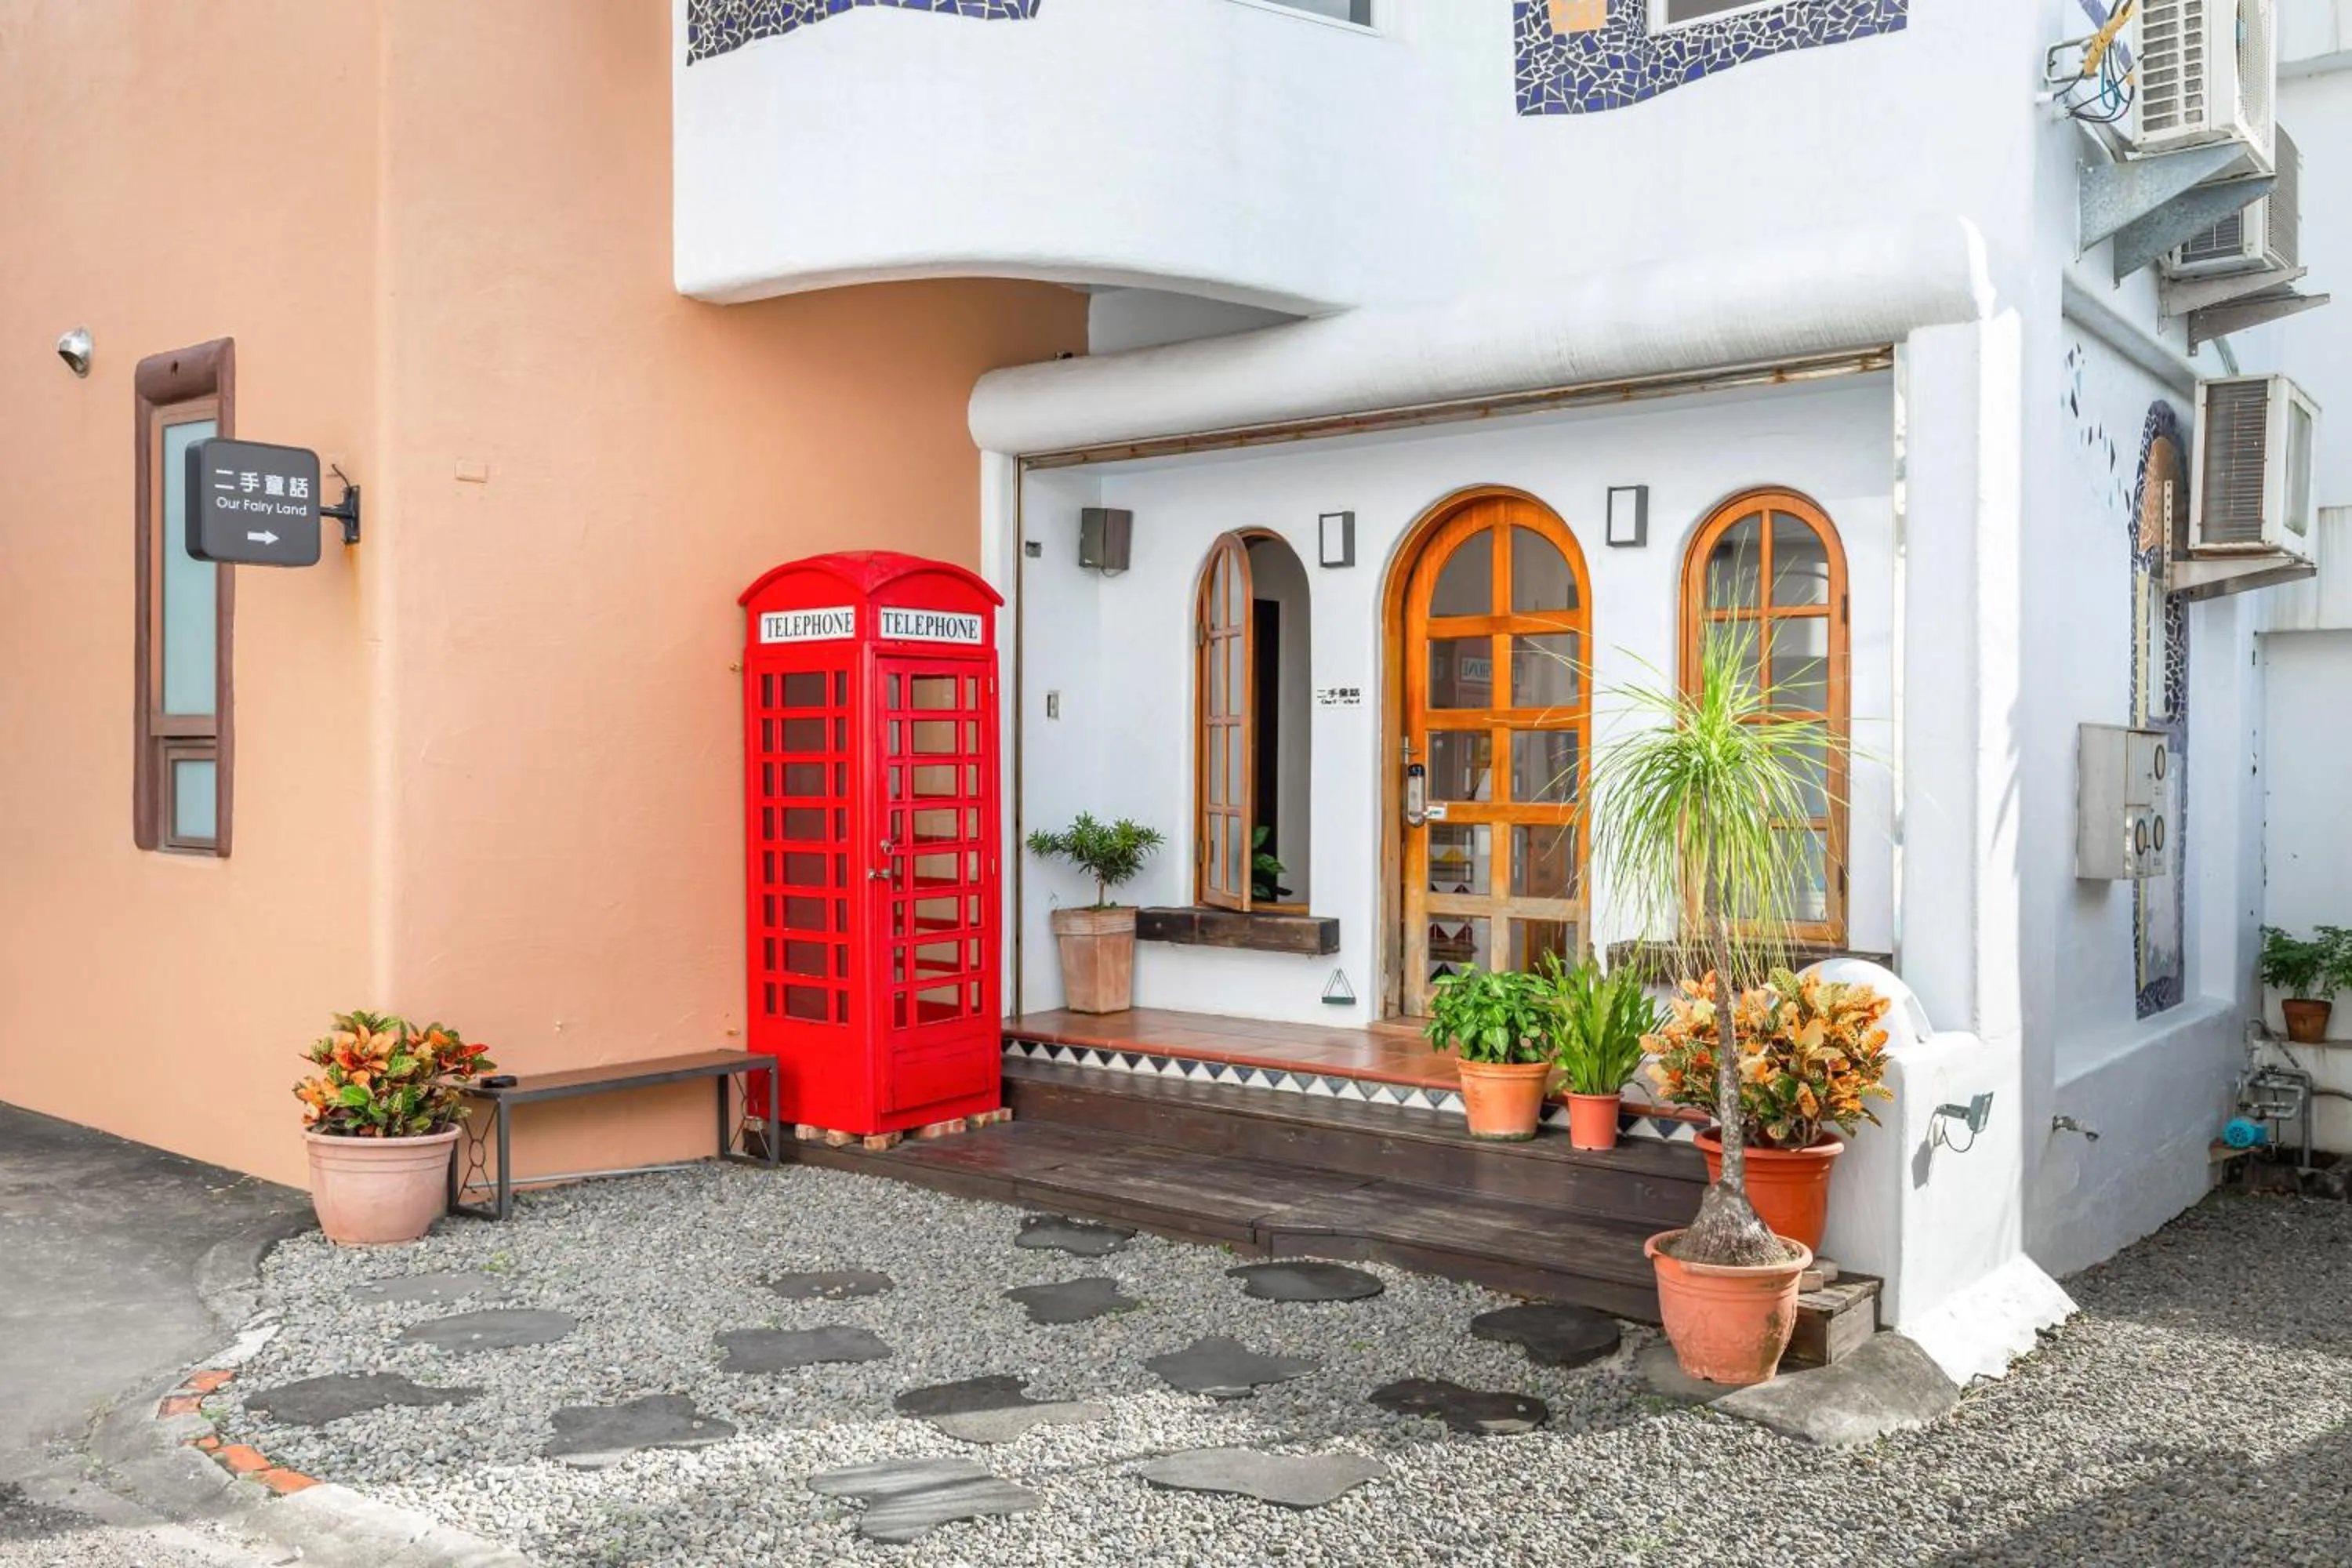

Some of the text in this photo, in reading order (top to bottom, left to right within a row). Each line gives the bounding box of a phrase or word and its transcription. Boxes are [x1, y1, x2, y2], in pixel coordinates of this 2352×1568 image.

[214, 468, 309, 499] 二手童話
[216, 496, 307, 517] Our Fairy Land
[764, 612, 855, 639] TELEPHONE
[882, 612, 978, 640] TELEPHONE
